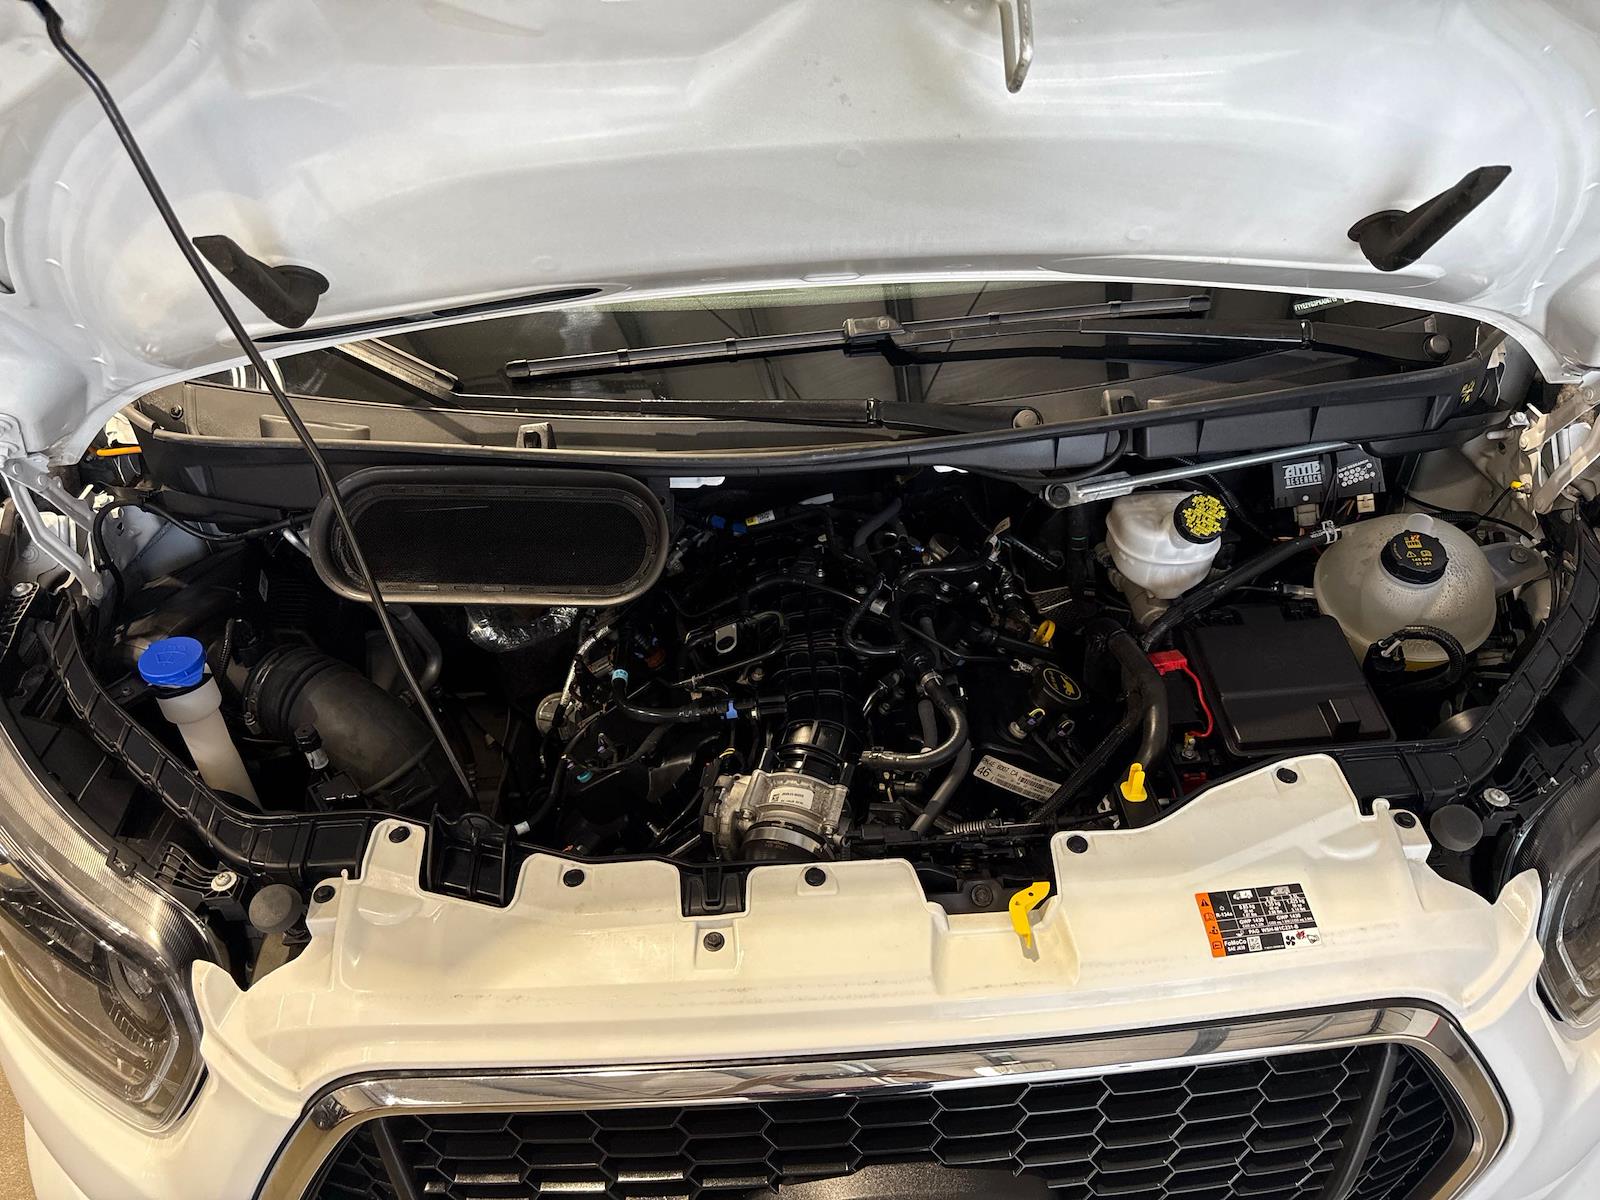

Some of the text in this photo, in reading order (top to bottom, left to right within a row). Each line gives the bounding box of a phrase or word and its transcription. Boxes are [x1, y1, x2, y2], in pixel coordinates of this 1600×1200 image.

[1283, 461, 1321, 478] AMP
[1286, 473, 1322, 486] RESEARCH
[977, 766, 991, 777] 46
